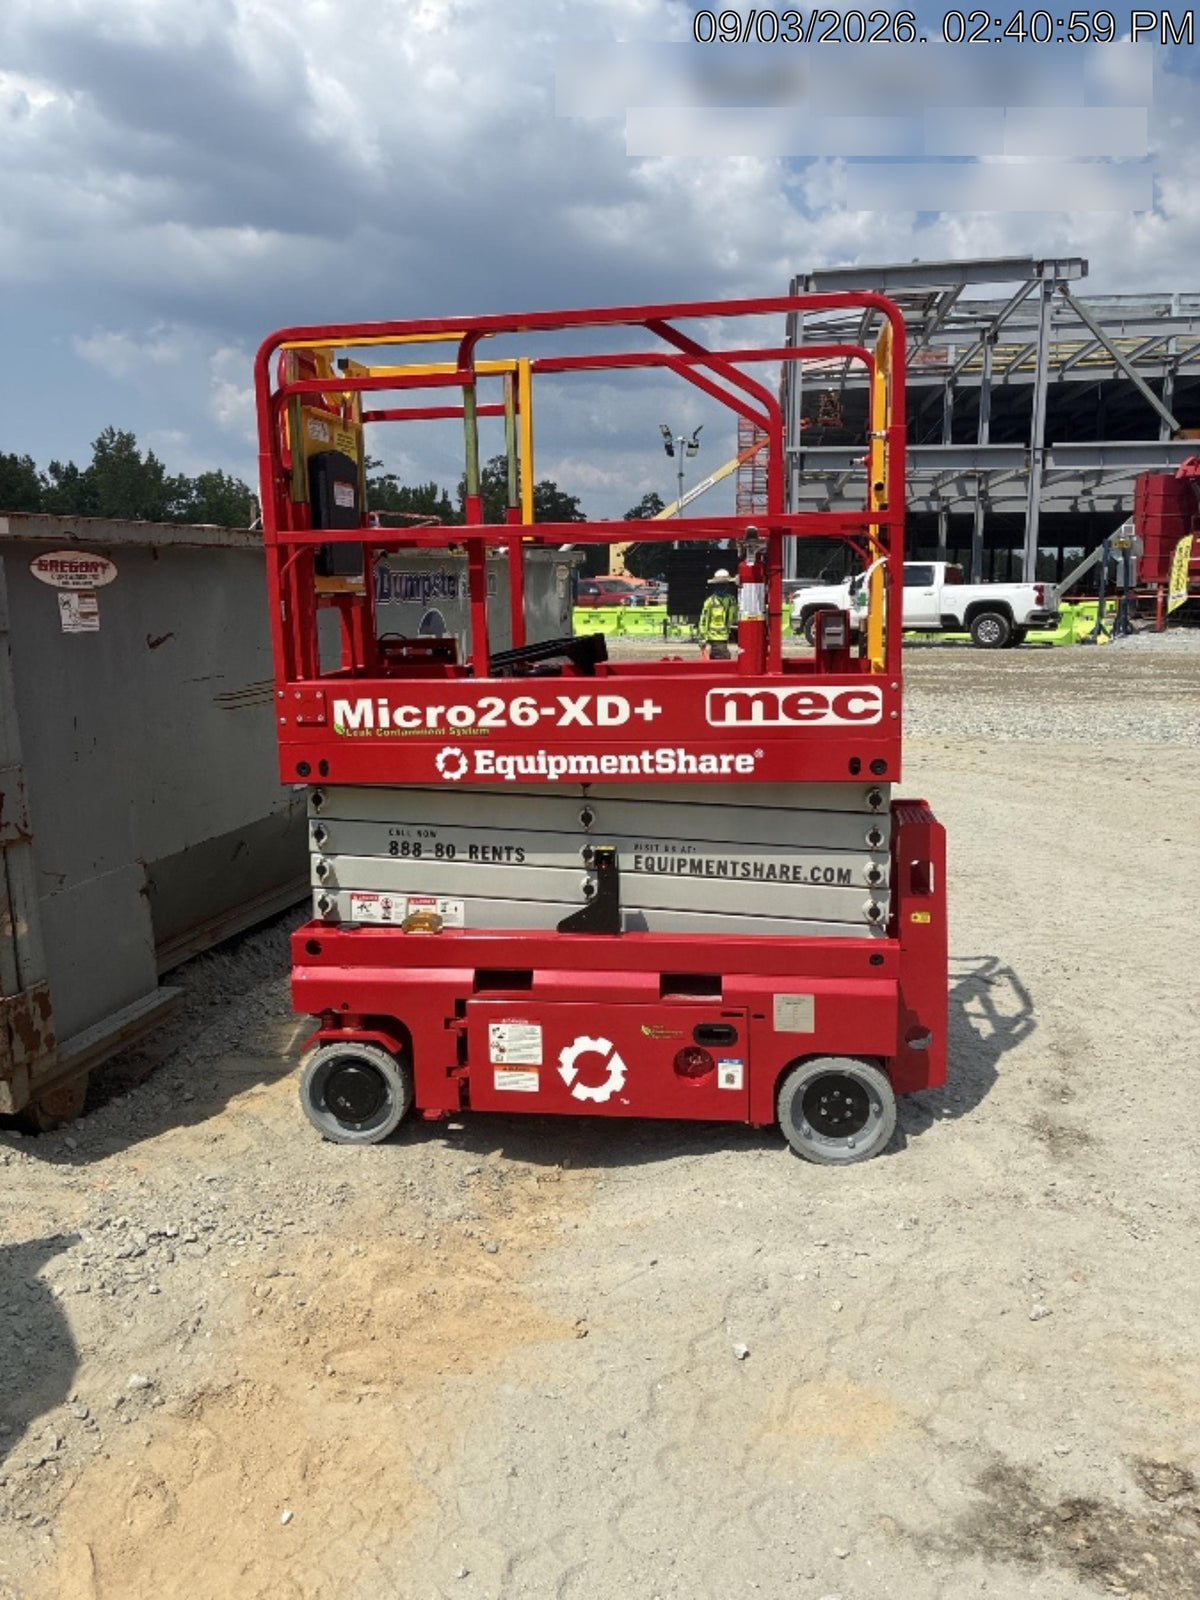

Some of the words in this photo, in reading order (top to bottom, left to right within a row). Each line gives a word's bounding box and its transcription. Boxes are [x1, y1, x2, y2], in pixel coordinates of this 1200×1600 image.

[37, 559, 110, 575] GREGORY
[333, 695, 662, 729] Micro26-XD+
[709, 691, 881, 722] mec
[346, 727, 372, 737] Leak
[633, 854, 853, 884] EQUIPMENTSHARE.COM
